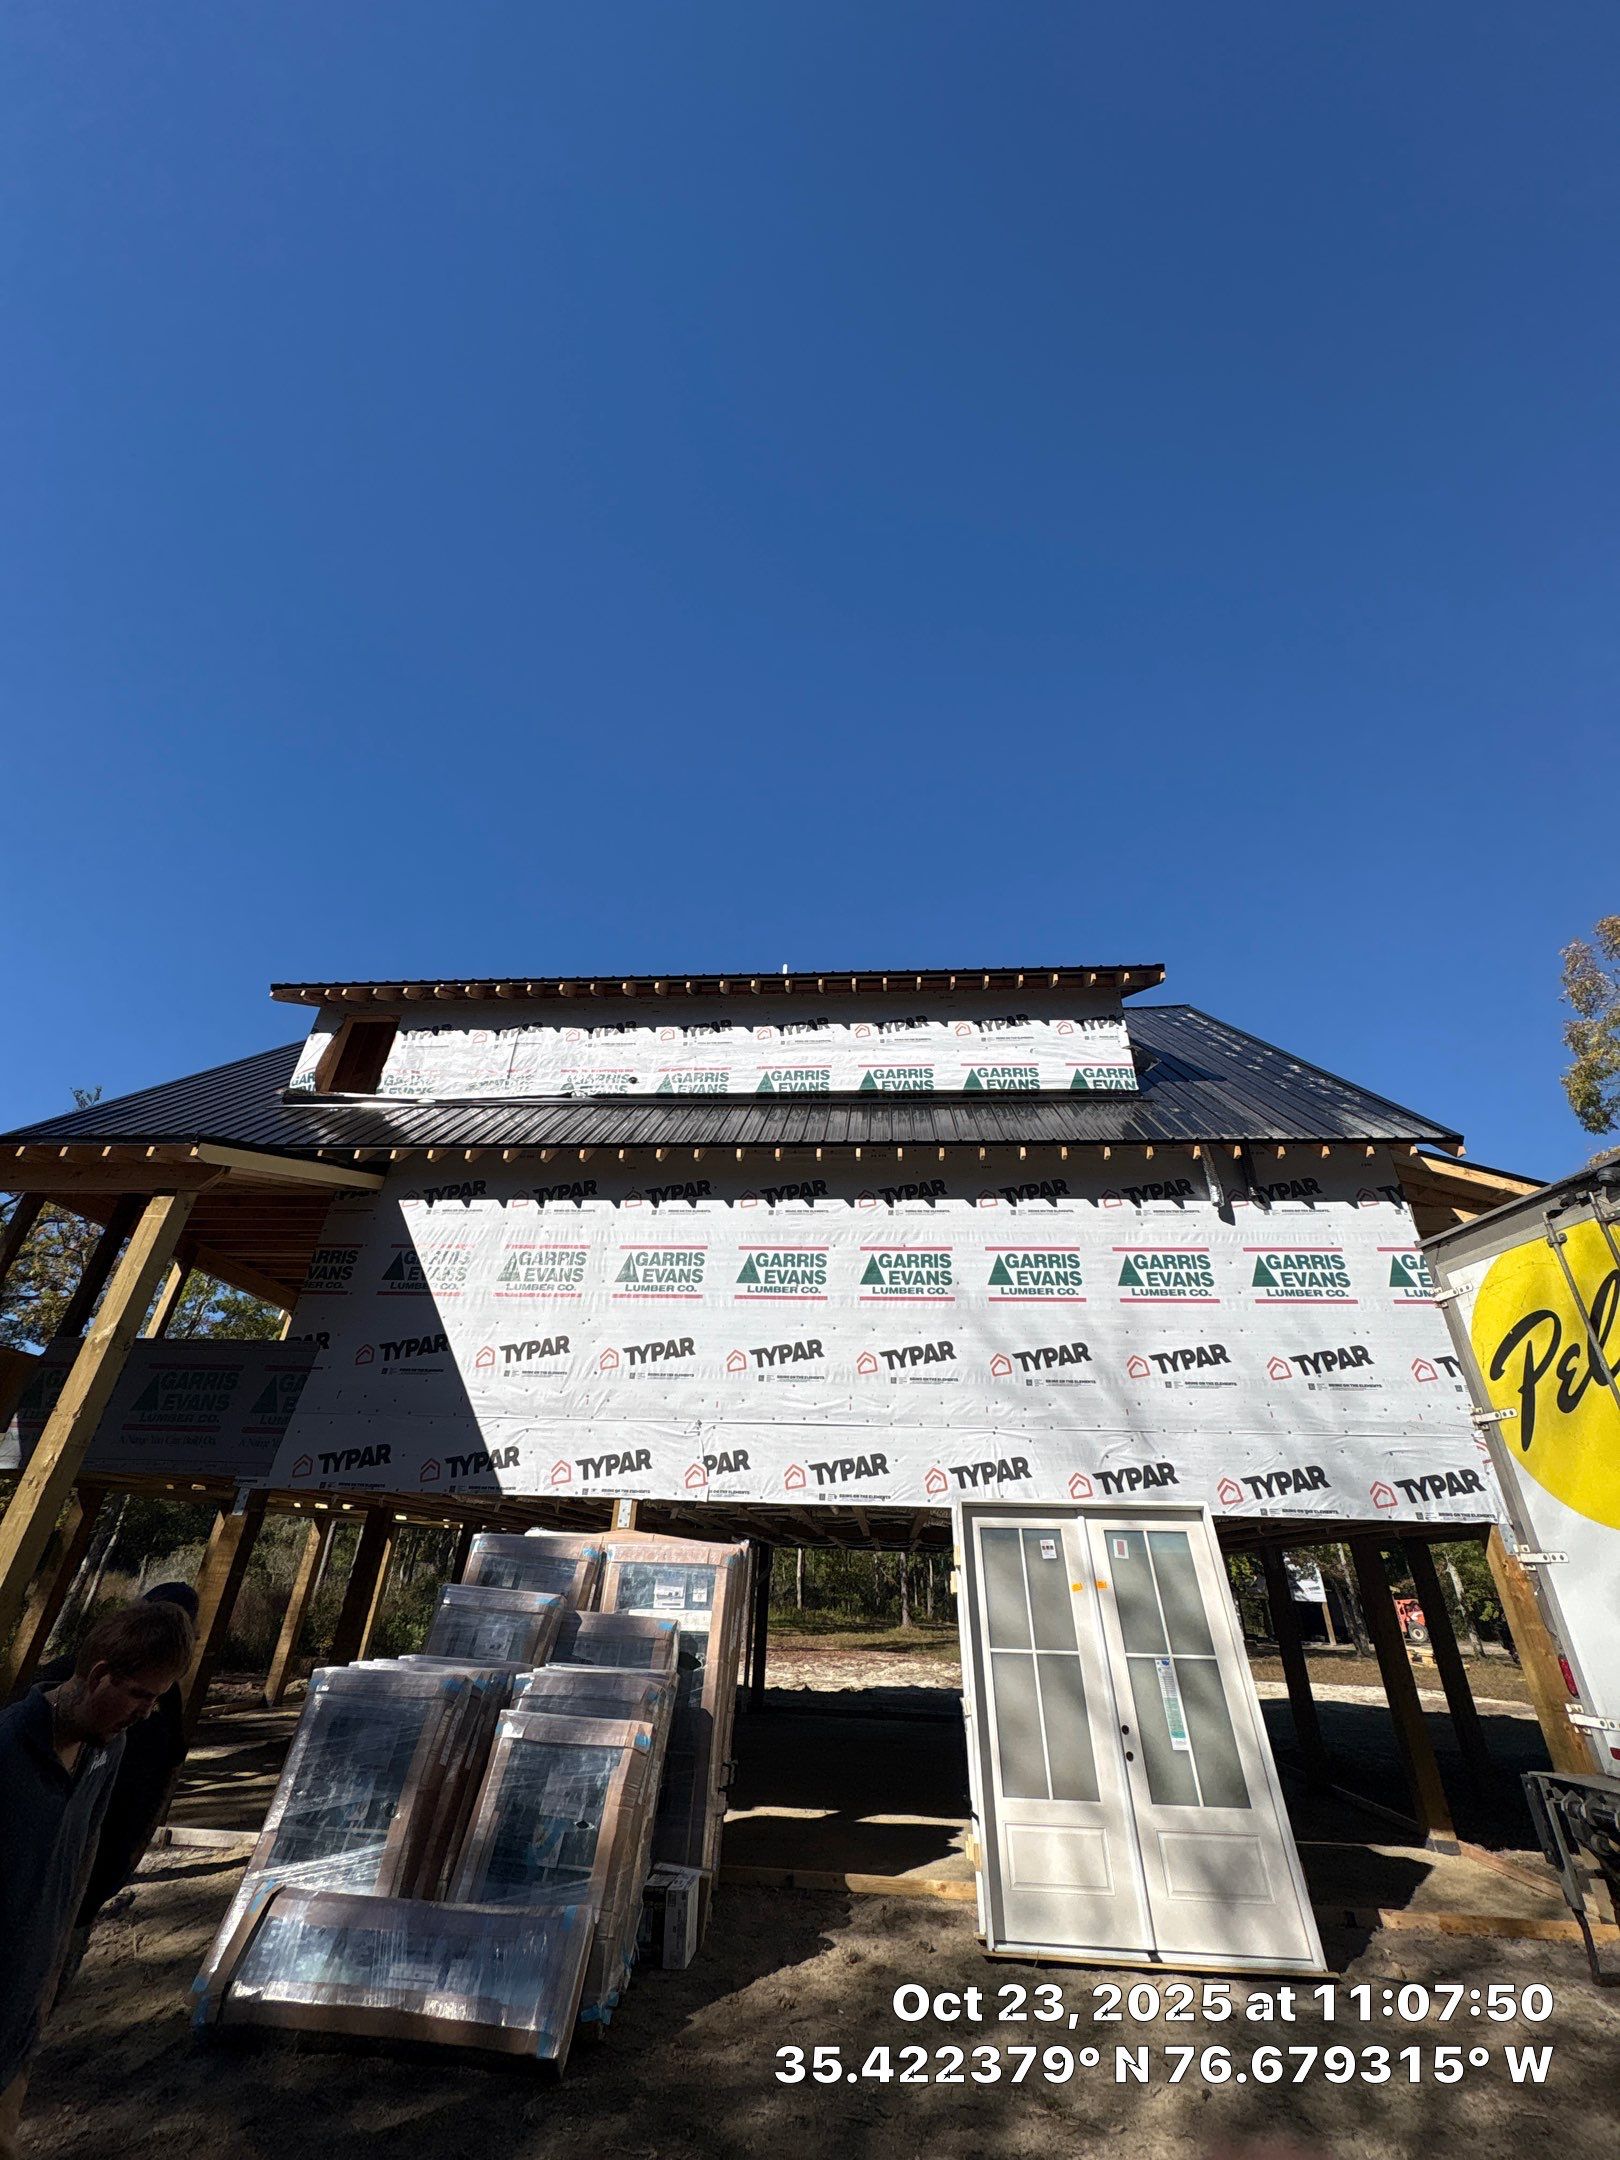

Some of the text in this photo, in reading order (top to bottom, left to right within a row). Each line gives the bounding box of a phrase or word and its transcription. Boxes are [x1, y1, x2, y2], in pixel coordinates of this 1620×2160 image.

[678, 1019, 733, 1038] TYPAR
[774, 1017, 830, 1036] TYPAR
[872, 1015, 930, 1035] TYPAR
[971, 1013, 1032, 1033] TYPAR
[672, 1072, 729, 1083] GARRIS
[771, 1070, 830, 1081] GARRIS
[873, 1068, 934, 1079] GARRIS
[977, 1067, 1040, 1078] GARRIS
[678, 1084, 728, 1093] EVANS
[778, 1082, 830, 1092] EVANS
[882, 1080, 935, 1090] EVANS
[987, 1079, 1041, 1090] EVANS
[424, 1180, 487, 1203] TYPAR
[533, 1180, 598, 1203] TYPAR
[645, 1180, 711, 1203] TYPAR
[760, 1179, 828, 1203] TYPAR
[878, 1179, 948, 1203] TYPAR
[998, 1179, 1070, 1203] TYPAR
[1121, 1179, 1194, 1203] TYPAR
[519, 1251, 586, 1266] GARRIS
[636, 1252, 705, 1267] GARRIS
[755, 1253, 827, 1268] GARRIS
[879, 1253, 952, 1268] GARRIS
[1005, 1253, 1081, 1269] GARRIS
[1133, 1254, 1211, 1269] GARRIS
[1266, 1254, 1346, 1270] GARRIS
[523, 1267, 583, 1282] EVANS
[642, 1268, 704, 1283] EVANS
[764, 1270, 827, 1285] EVANS
[888, 1270, 953, 1285] EVANS
[1016, 1271, 1082, 1286] EVANS
[1146, 1271, 1215, 1287] EVANS
[1283, 1272, 1351, 1288] EVANS
[506, 1283, 577, 1291] LUMBER CO.
[625, 1284, 697, 1292] LUMBER CO.
[747, 1285, 821, 1294] LUMBER CO.
[872, 1286, 948, 1295] LUMBER CO.
[1001, 1286, 1079, 1296] LUMBER CO.
[1131, 1287, 1212, 1297] LUMBER CO.
[1266, 1289, 1349, 1298] LUMBER CO.
[379, 1333, 448, 1361] TYPAR
[499, 1335, 570, 1363] TYPAR
[622, 1337, 696, 1365] TYPAR
[749, 1339, 824, 1368] TYPAR
[879, 1340, 957, 1370] TYPAR
[1012, 1342, 1092, 1372] TYPAR
[1149, 1343, 1231, 1374] TYPAR
[1289, 1344, 1375, 1376] TYPAR
[160, 1372, 240, 1391] GARRIS
[160, 1394, 230, 1411] EVANS
[318, 1443, 391, 1475] TYPAR
[445, 1446, 521, 1478] TYPAR
[575, 1448, 653, 1480] TYPAR
[808, 1453, 890, 1485] TYPAR
[949, 1456, 1032, 1489] TYPAR
[1092, 1462, 1180, 1495] TYPAR
[1239, 1465, 1331, 1500] TYPAR
[1394, 1469, 1487, 1503] TYPAR
